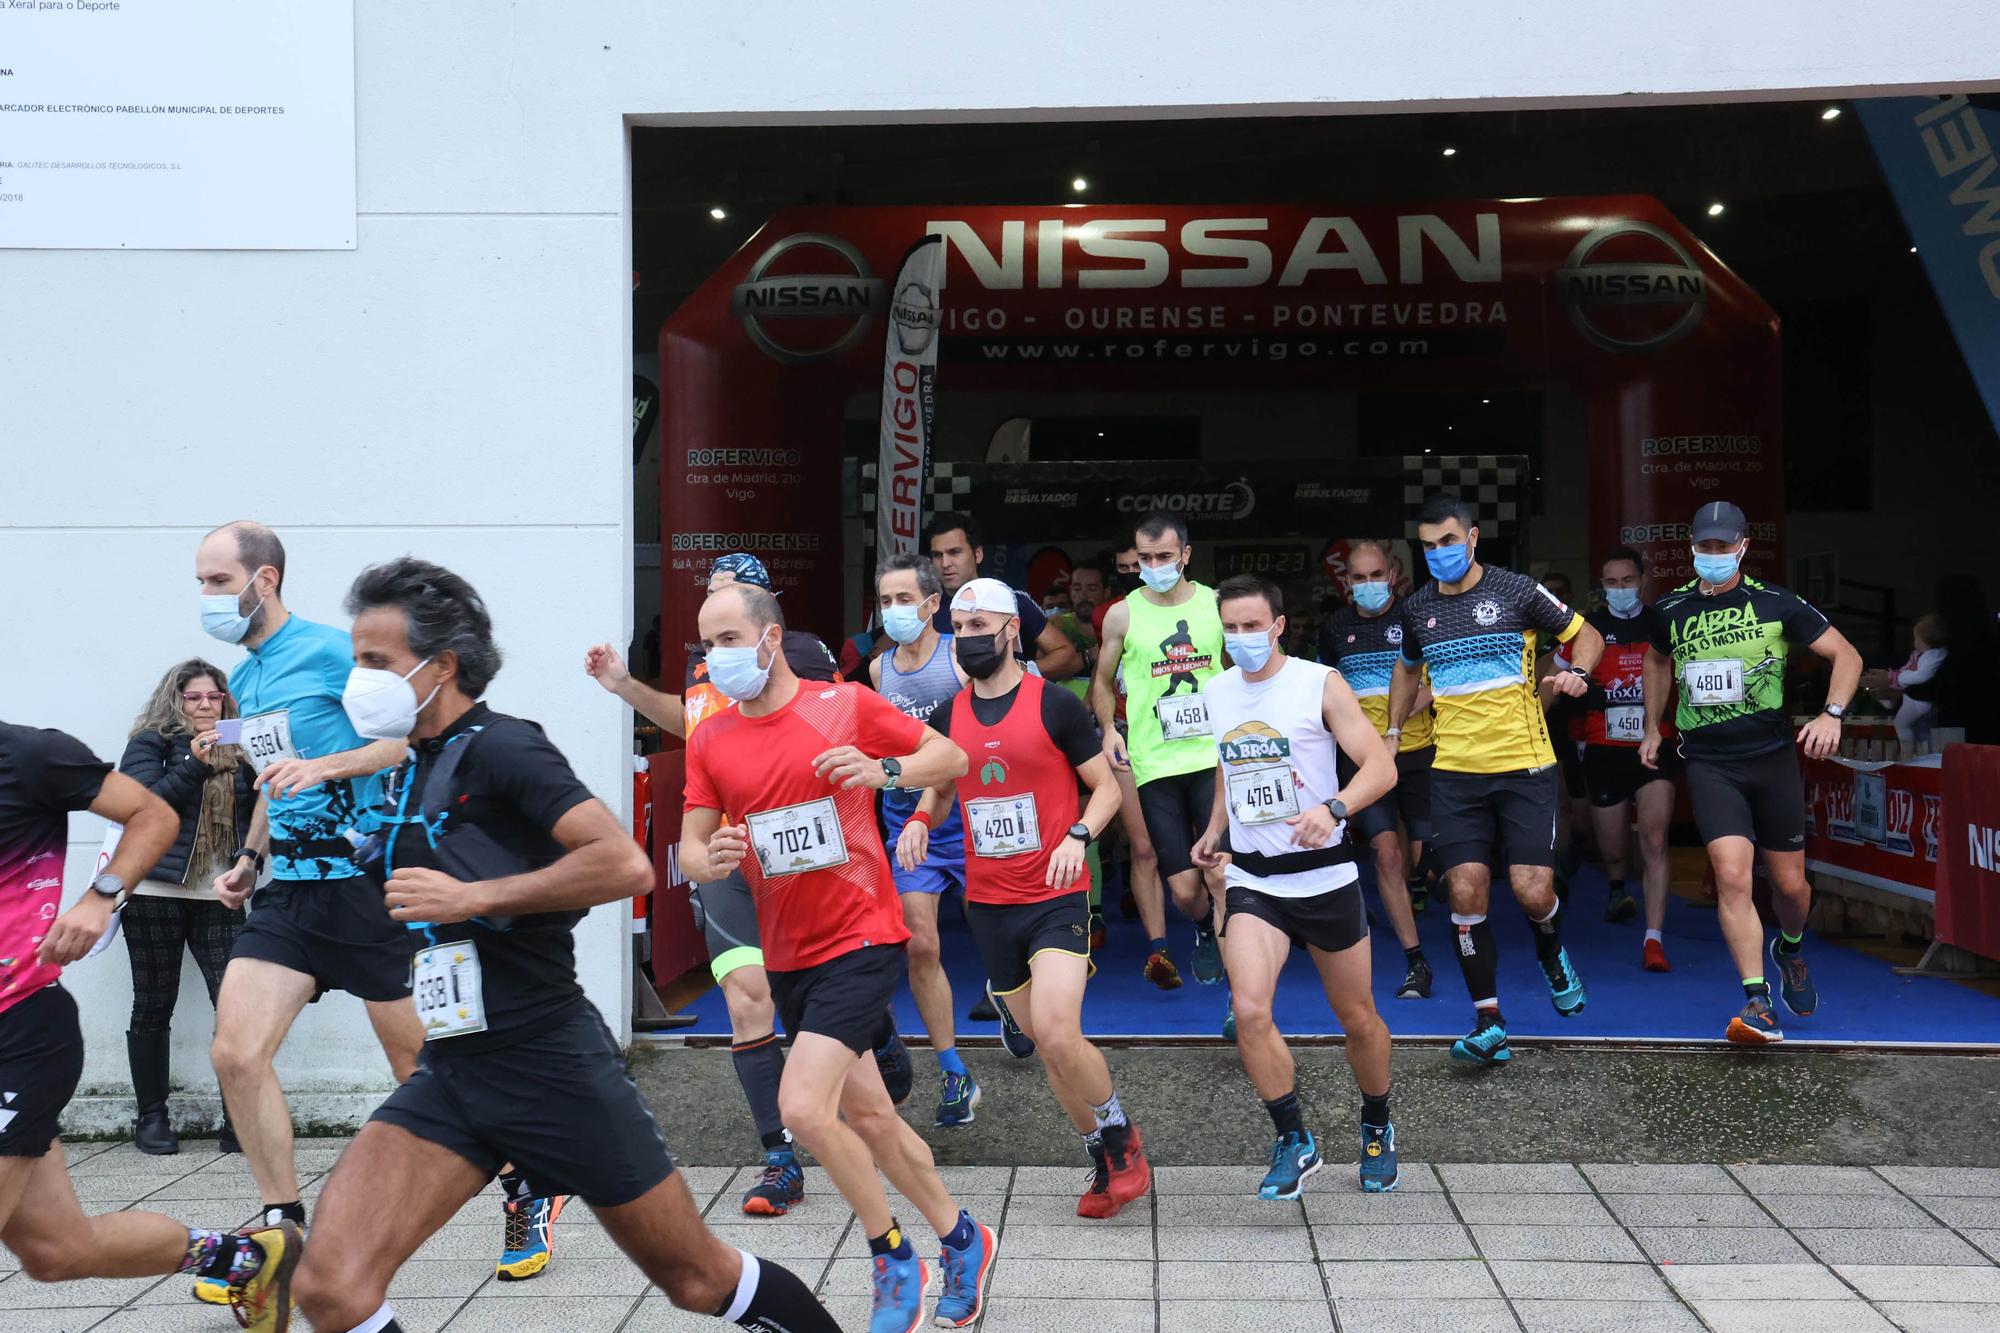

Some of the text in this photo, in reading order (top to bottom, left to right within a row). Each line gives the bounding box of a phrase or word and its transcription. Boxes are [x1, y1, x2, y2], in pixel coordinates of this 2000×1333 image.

[9, 0, 36, 9] Xeral
[40, 1, 63, 11] para
[77, 0, 120, 12] Deporte
[47, 104, 113, 113] ELECTRÓNICO
[116, 104, 165, 113] PABELLÓN
[926, 213, 1502, 289] NISSAN
[1570, 275, 1701, 296] NISSAN
[745, 287, 870, 307] NISSAN
[939, 307, 1007, 330] IGO
[1065, 306, 1226, 330] OURENSE
[1272, 301, 1508, 328] PONTEVEDRA
[981, 337, 1429, 361] www.rofervigo.com
[1640, 435, 1761, 455] ROFERVIGO
[688, 449, 800, 467] ROFERVIGO
[892, 361, 921, 554] ERVIGO
[1641, 462, 1672, 474] Ctra.
[1674, 461, 1691, 472] de
[1695, 461, 1742, 473] Madrid,
[686, 473, 711, 484] Ctra.
[714, 472, 728, 484] de
[731, 472, 779, 485] Madrid,
[1689, 477, 1720, 490] Vigo
[726, 488, 756, 502] Vigo
[1003, 493, 1078, 504] RESULTADOS
[1116, 493, 1233, 513] CCNORTE
[673, 533, 820, 551] ROFEROURENSE
[1652, 567, 1675, 577] San
[1682, 600, 1759, 641] CABRA
[1711, 627, 1764, 647] MONTE
[1173, 663, 1181, 671] de
[1697, 675, 1723, 691] 480
[1176, 707, 1201, 725] 458
[1618, 717, 1639, 731] 450
[250, 733, 276, 758] 539
[1225, 740, 1283, 760] A BROA
[1247, 786, 1273, 807] 476
[985, 818, 1014, 838] 420
[773, 826, 813, 855] 702
